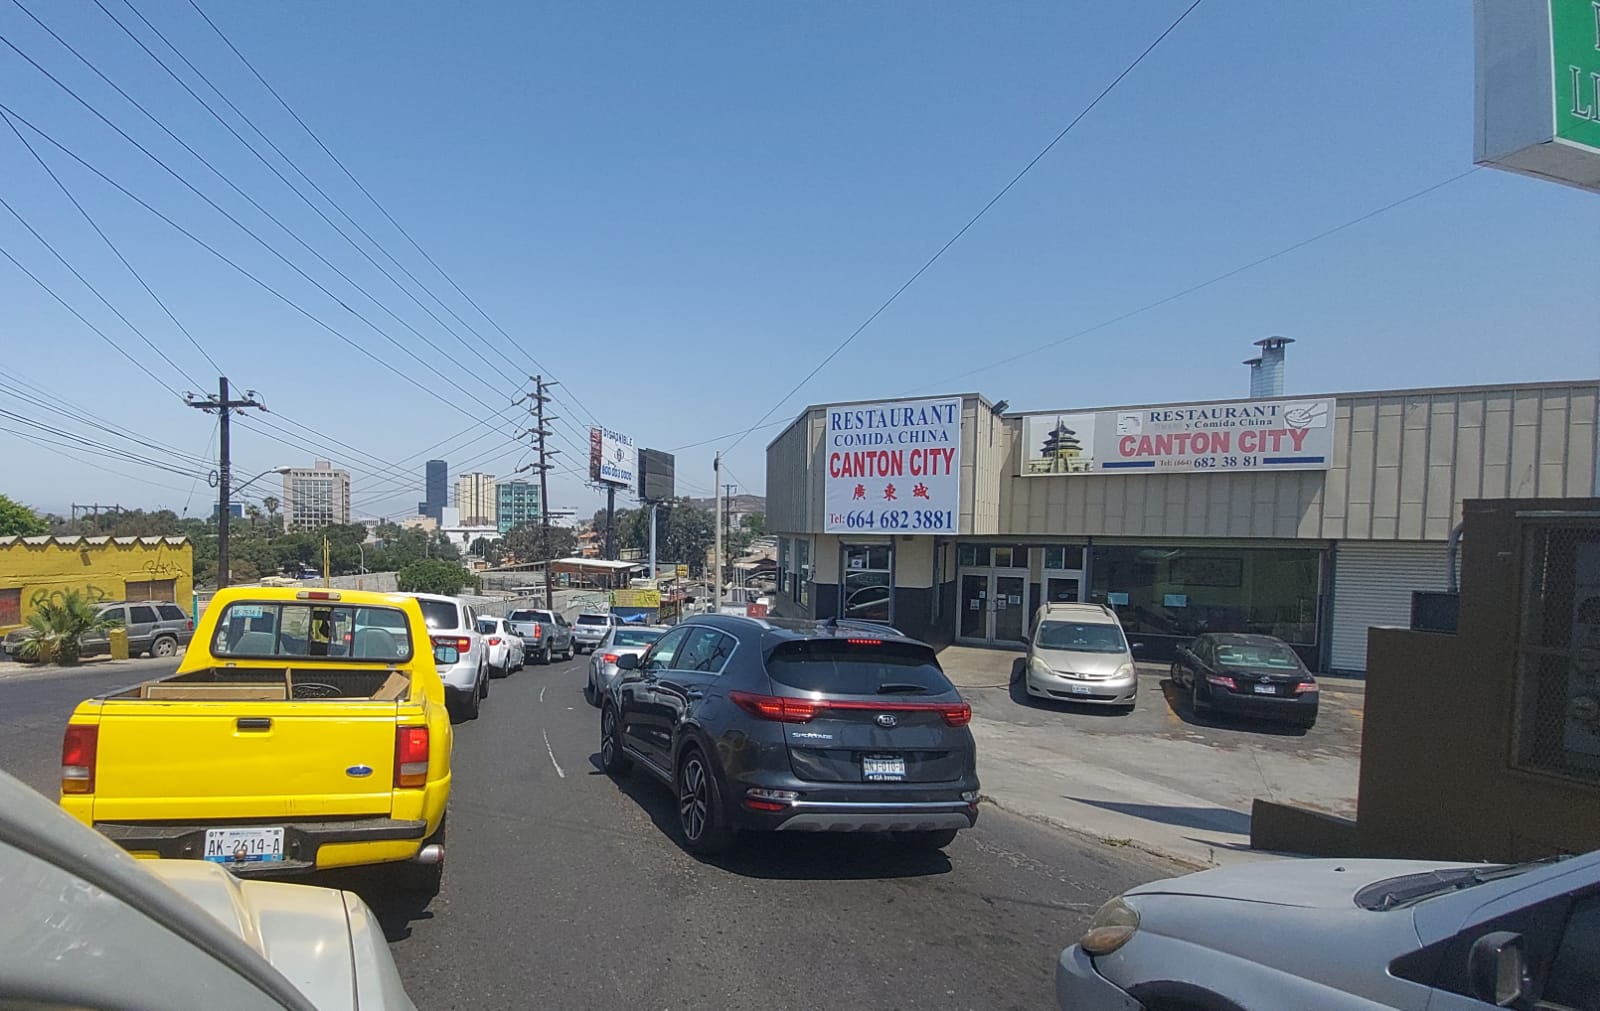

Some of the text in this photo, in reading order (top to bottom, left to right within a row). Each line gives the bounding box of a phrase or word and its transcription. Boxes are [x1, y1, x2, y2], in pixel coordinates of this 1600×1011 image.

[832, 404, 956, 430] RESTAURANT
[1150, 405, 1280, 422] RESTAURANT
[1185, 422, 1191, 430] y
[1194, 419, 1236, 429] Comida
[1239, 417, 1273, 426] China
[834, 429, 949, 447] COMIDA CHINA
[1119, 428, 1310, 457] CANTON CITY
[829, 447, 956, 478] CANTON CITY
[1194, 457, 1216, 468] 682
[1222, 456, 1237, 467] 38
[1243, 455, 1257, 466] 81
[829, 510, 953, 529] Tel: 664 682 3881
[208, 838, 280, 855] AK-2614-A
